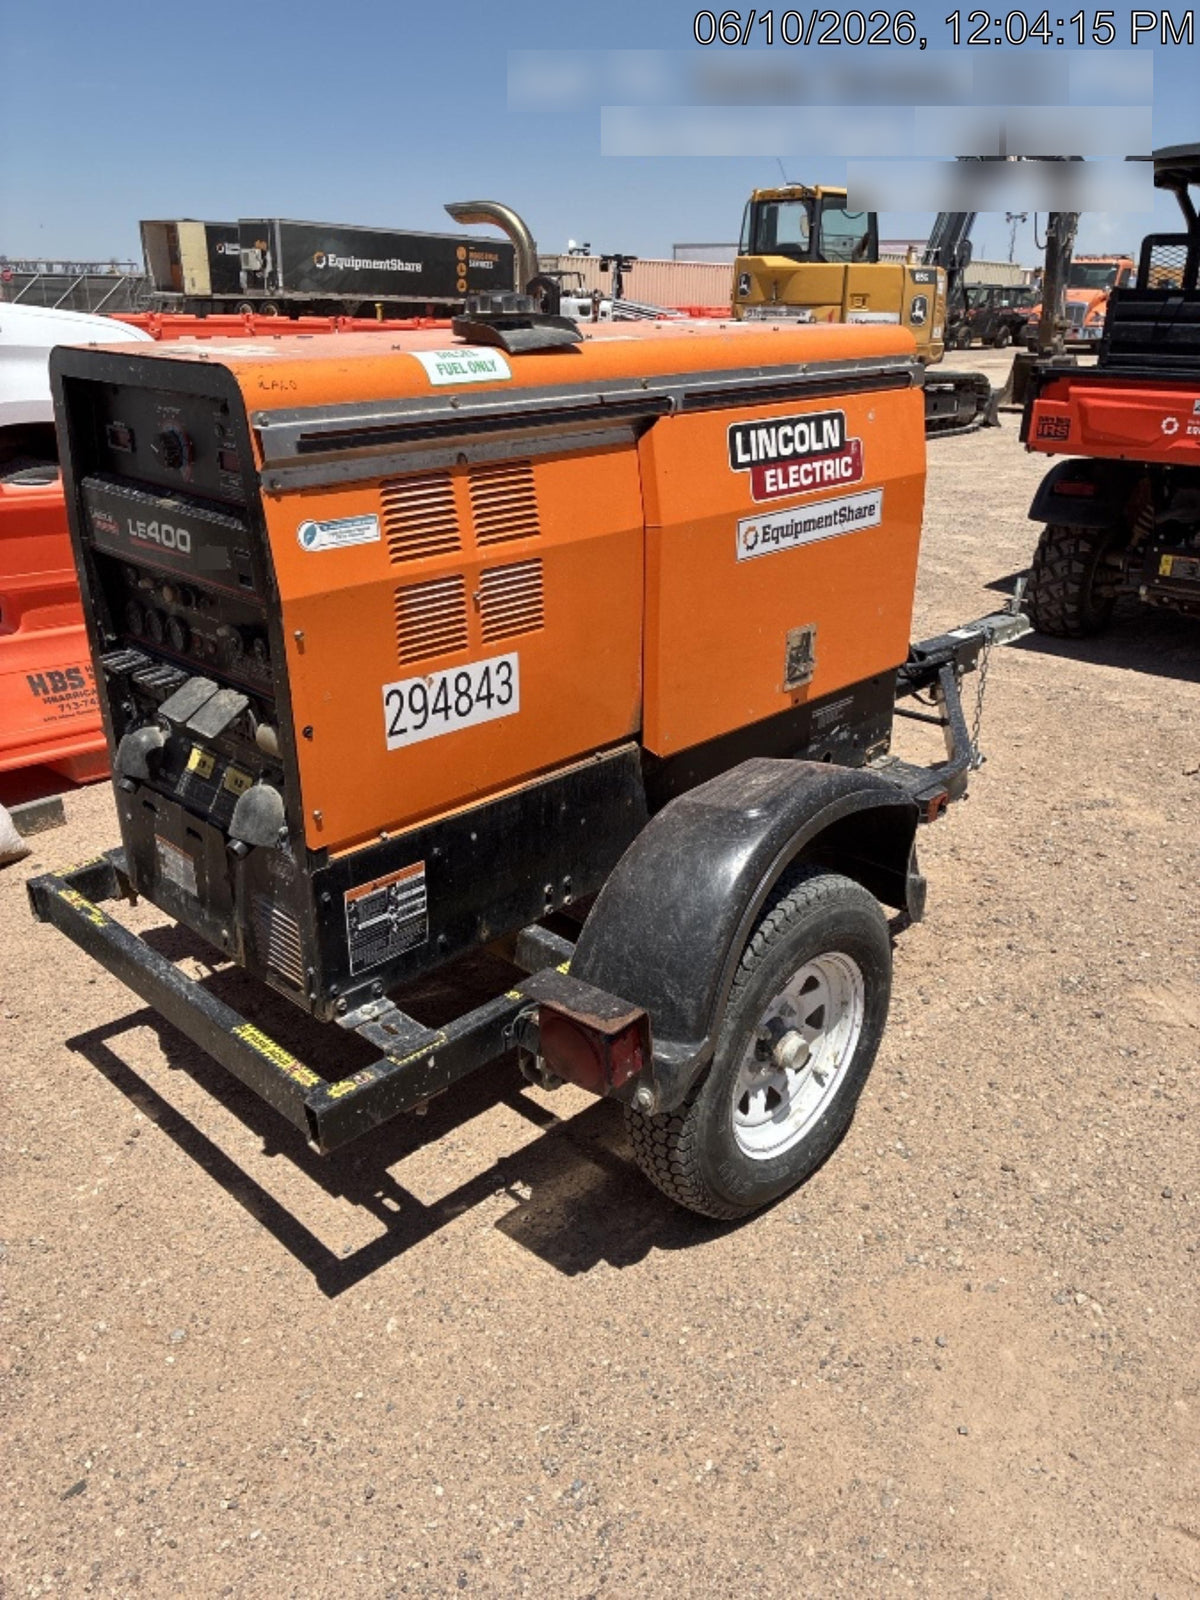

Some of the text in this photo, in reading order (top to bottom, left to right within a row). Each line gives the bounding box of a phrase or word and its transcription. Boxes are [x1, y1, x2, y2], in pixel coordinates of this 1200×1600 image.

[328, 253, 423, 273] EquipmentShare
[435, 359, 497, 376] FUEL ONLY
[734, 418, 841, 464] LINCOLN
[764, 456, 854, 493] ELECTRIC
[127, 518, 191, 554] LE400
[760, 503, 877, 545] EquipmentShare
[26, 666, 86, 698] HBS
[385, 660, 513, 738] 294843
